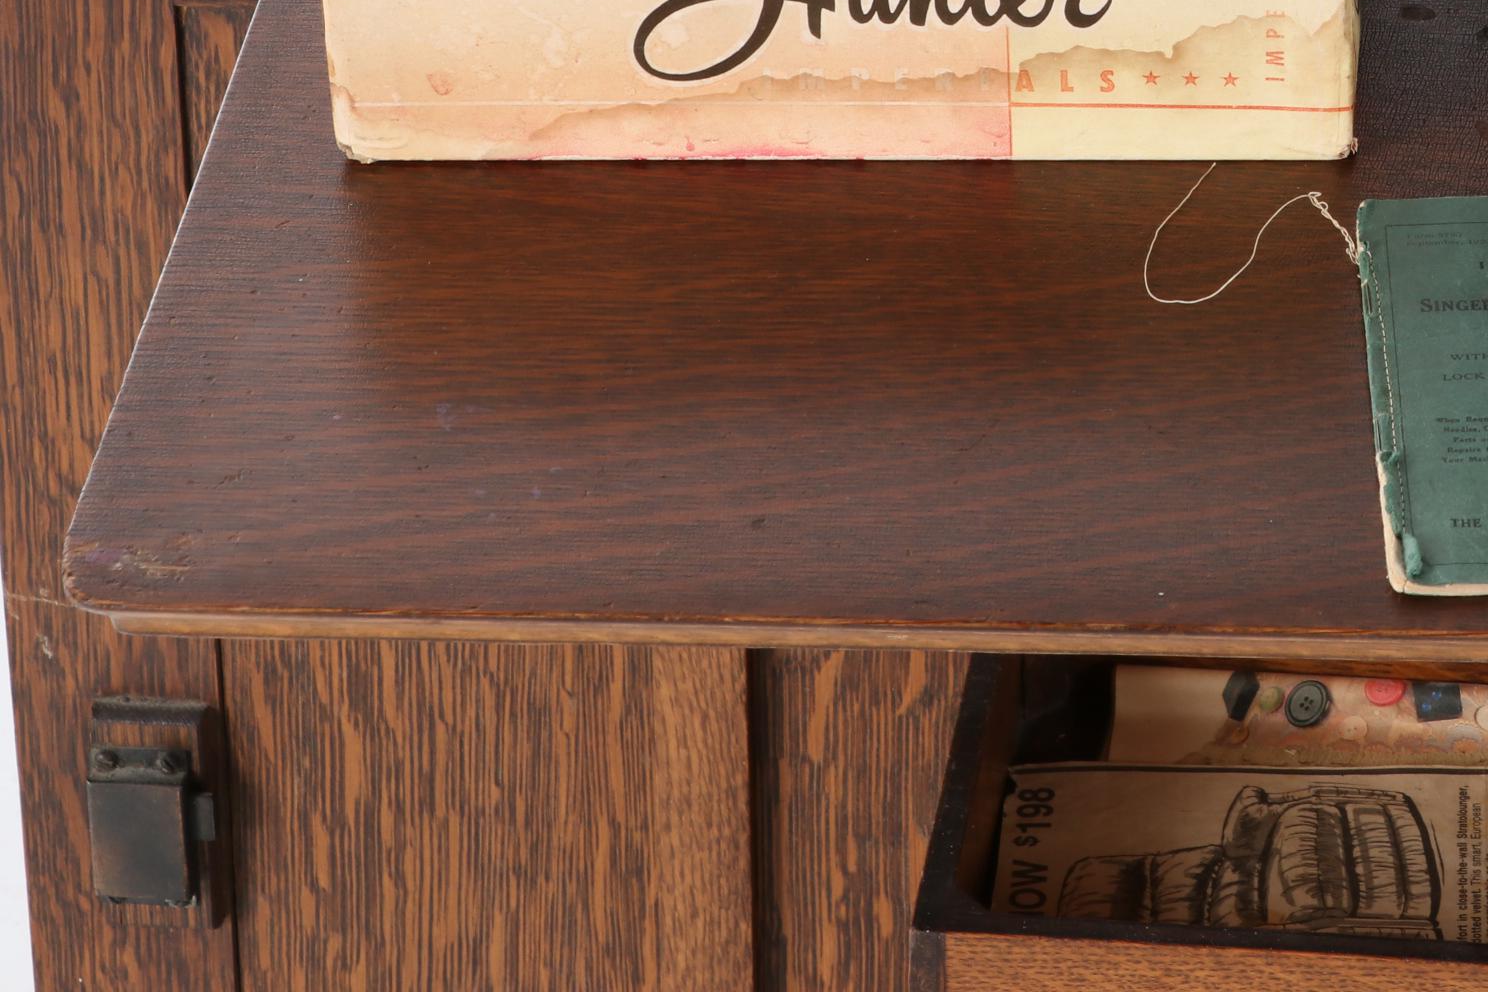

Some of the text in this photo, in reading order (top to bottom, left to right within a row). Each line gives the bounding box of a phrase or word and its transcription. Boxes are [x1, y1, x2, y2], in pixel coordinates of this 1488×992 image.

[1442, 372, 1487, 382] LOCK
[1450, 518, 1482, 528] THE
[1470, 802, 1483, 840] European
[1008, 786, 1056, 915] OW $198
[1456, 842, 1468, 911] close-to-the-wall
[1470, 868, 1482, 886] This
[1457, 913, 1468, 922] in
